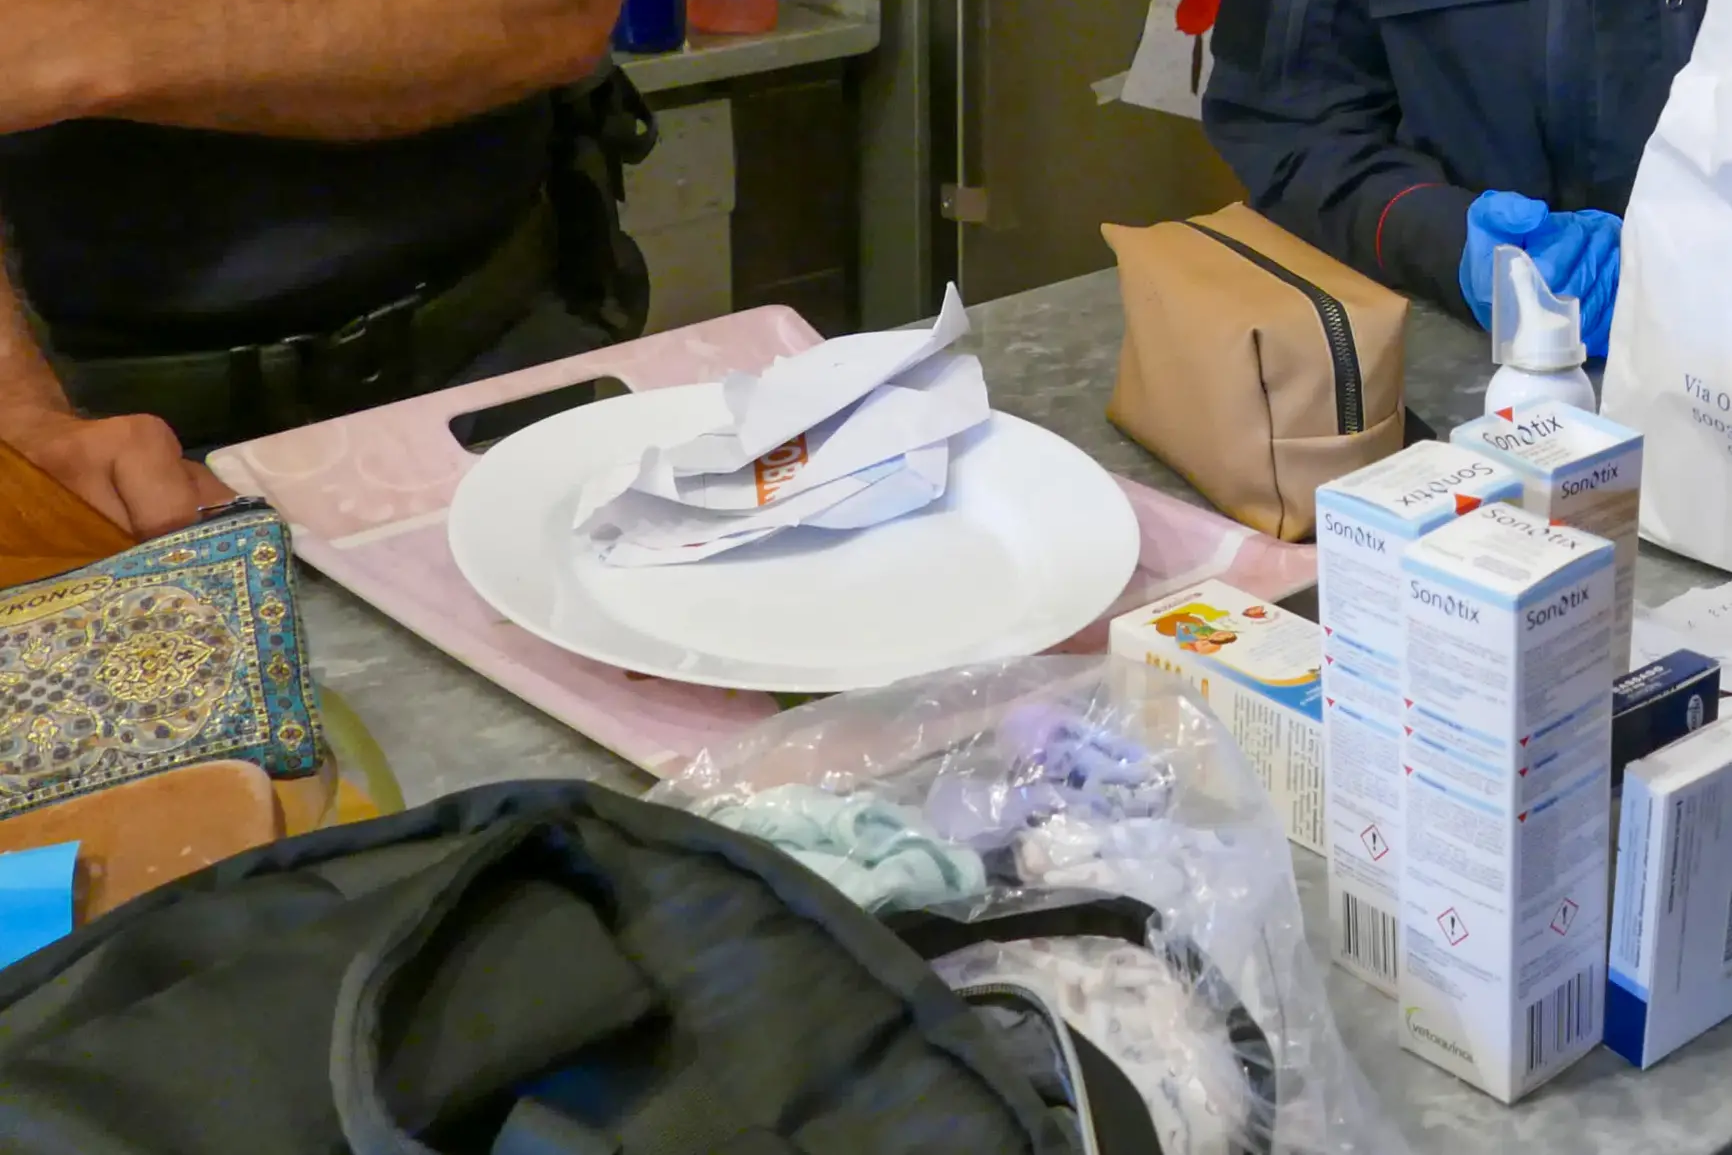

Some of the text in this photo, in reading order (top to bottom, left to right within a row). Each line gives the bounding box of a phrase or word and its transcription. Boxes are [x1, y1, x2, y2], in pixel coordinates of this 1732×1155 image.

[1684, 373, 1711, 404] Via
[1482, 414, 1565, 452] Sonotix
[1396, 462, 1494, 507] Sonotix
[1561, 462, 1620, 500] Sonotix
[1325, 513, 1387, 554] Sonotix
[1481, 508, 1581, 550] Sonotix
[0, 577, 108, 615] KONOS
[1410, 580, 1482, 625] Sonotix
[1525, 586, 1590, 632] Sonotix
